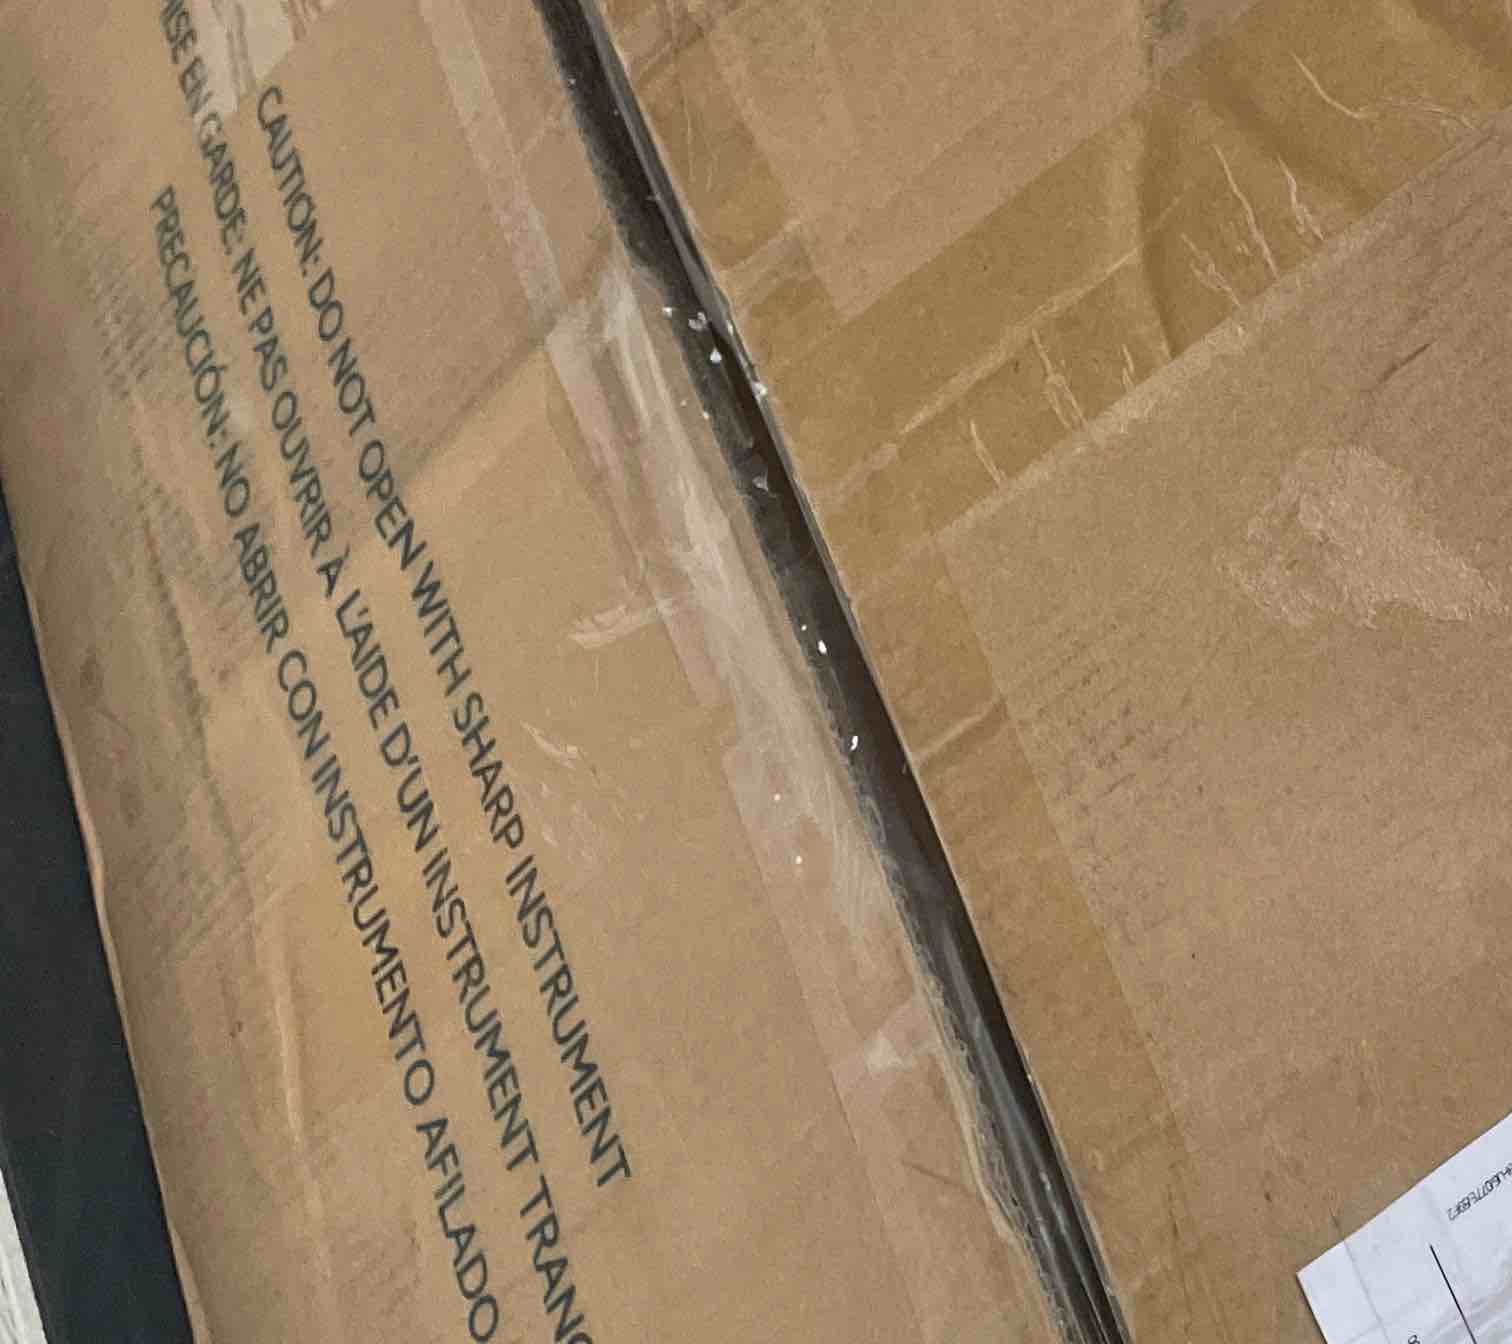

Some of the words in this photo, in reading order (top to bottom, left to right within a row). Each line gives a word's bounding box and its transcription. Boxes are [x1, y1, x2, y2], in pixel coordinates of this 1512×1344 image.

[178, 57, 212, 117] EN
[231, 255, 267, 315] NE
[247, 306, 289, 391] PAS
[271, 391, 333, 559] OUVRIR
[316, 546, 350, 597] À
[257, 86, 324, 277] CAUTION:
[308, 267, 344, 343] DO
[327, 338, 376, 438] NOT
[358, 439, 422, 570] OPEN
[411, 561, 473, 697] WITH
[453, 692, 525, 849] SHARP
[505, 855, 632, 1188] INSTRUMENT
[151, 185, 230, 451] PRECAUCIÓN:
[214, 445, 251, 519] NO
[233, 522, 290, 654] ABRIR
[277, 650, 331, 761] CON
[311, 754, 436, 1107] INSTRUMENTO
[415, 1117, 500, 1344] AFILADO
[422, 847, 540, 1172] INSTRUMENT
